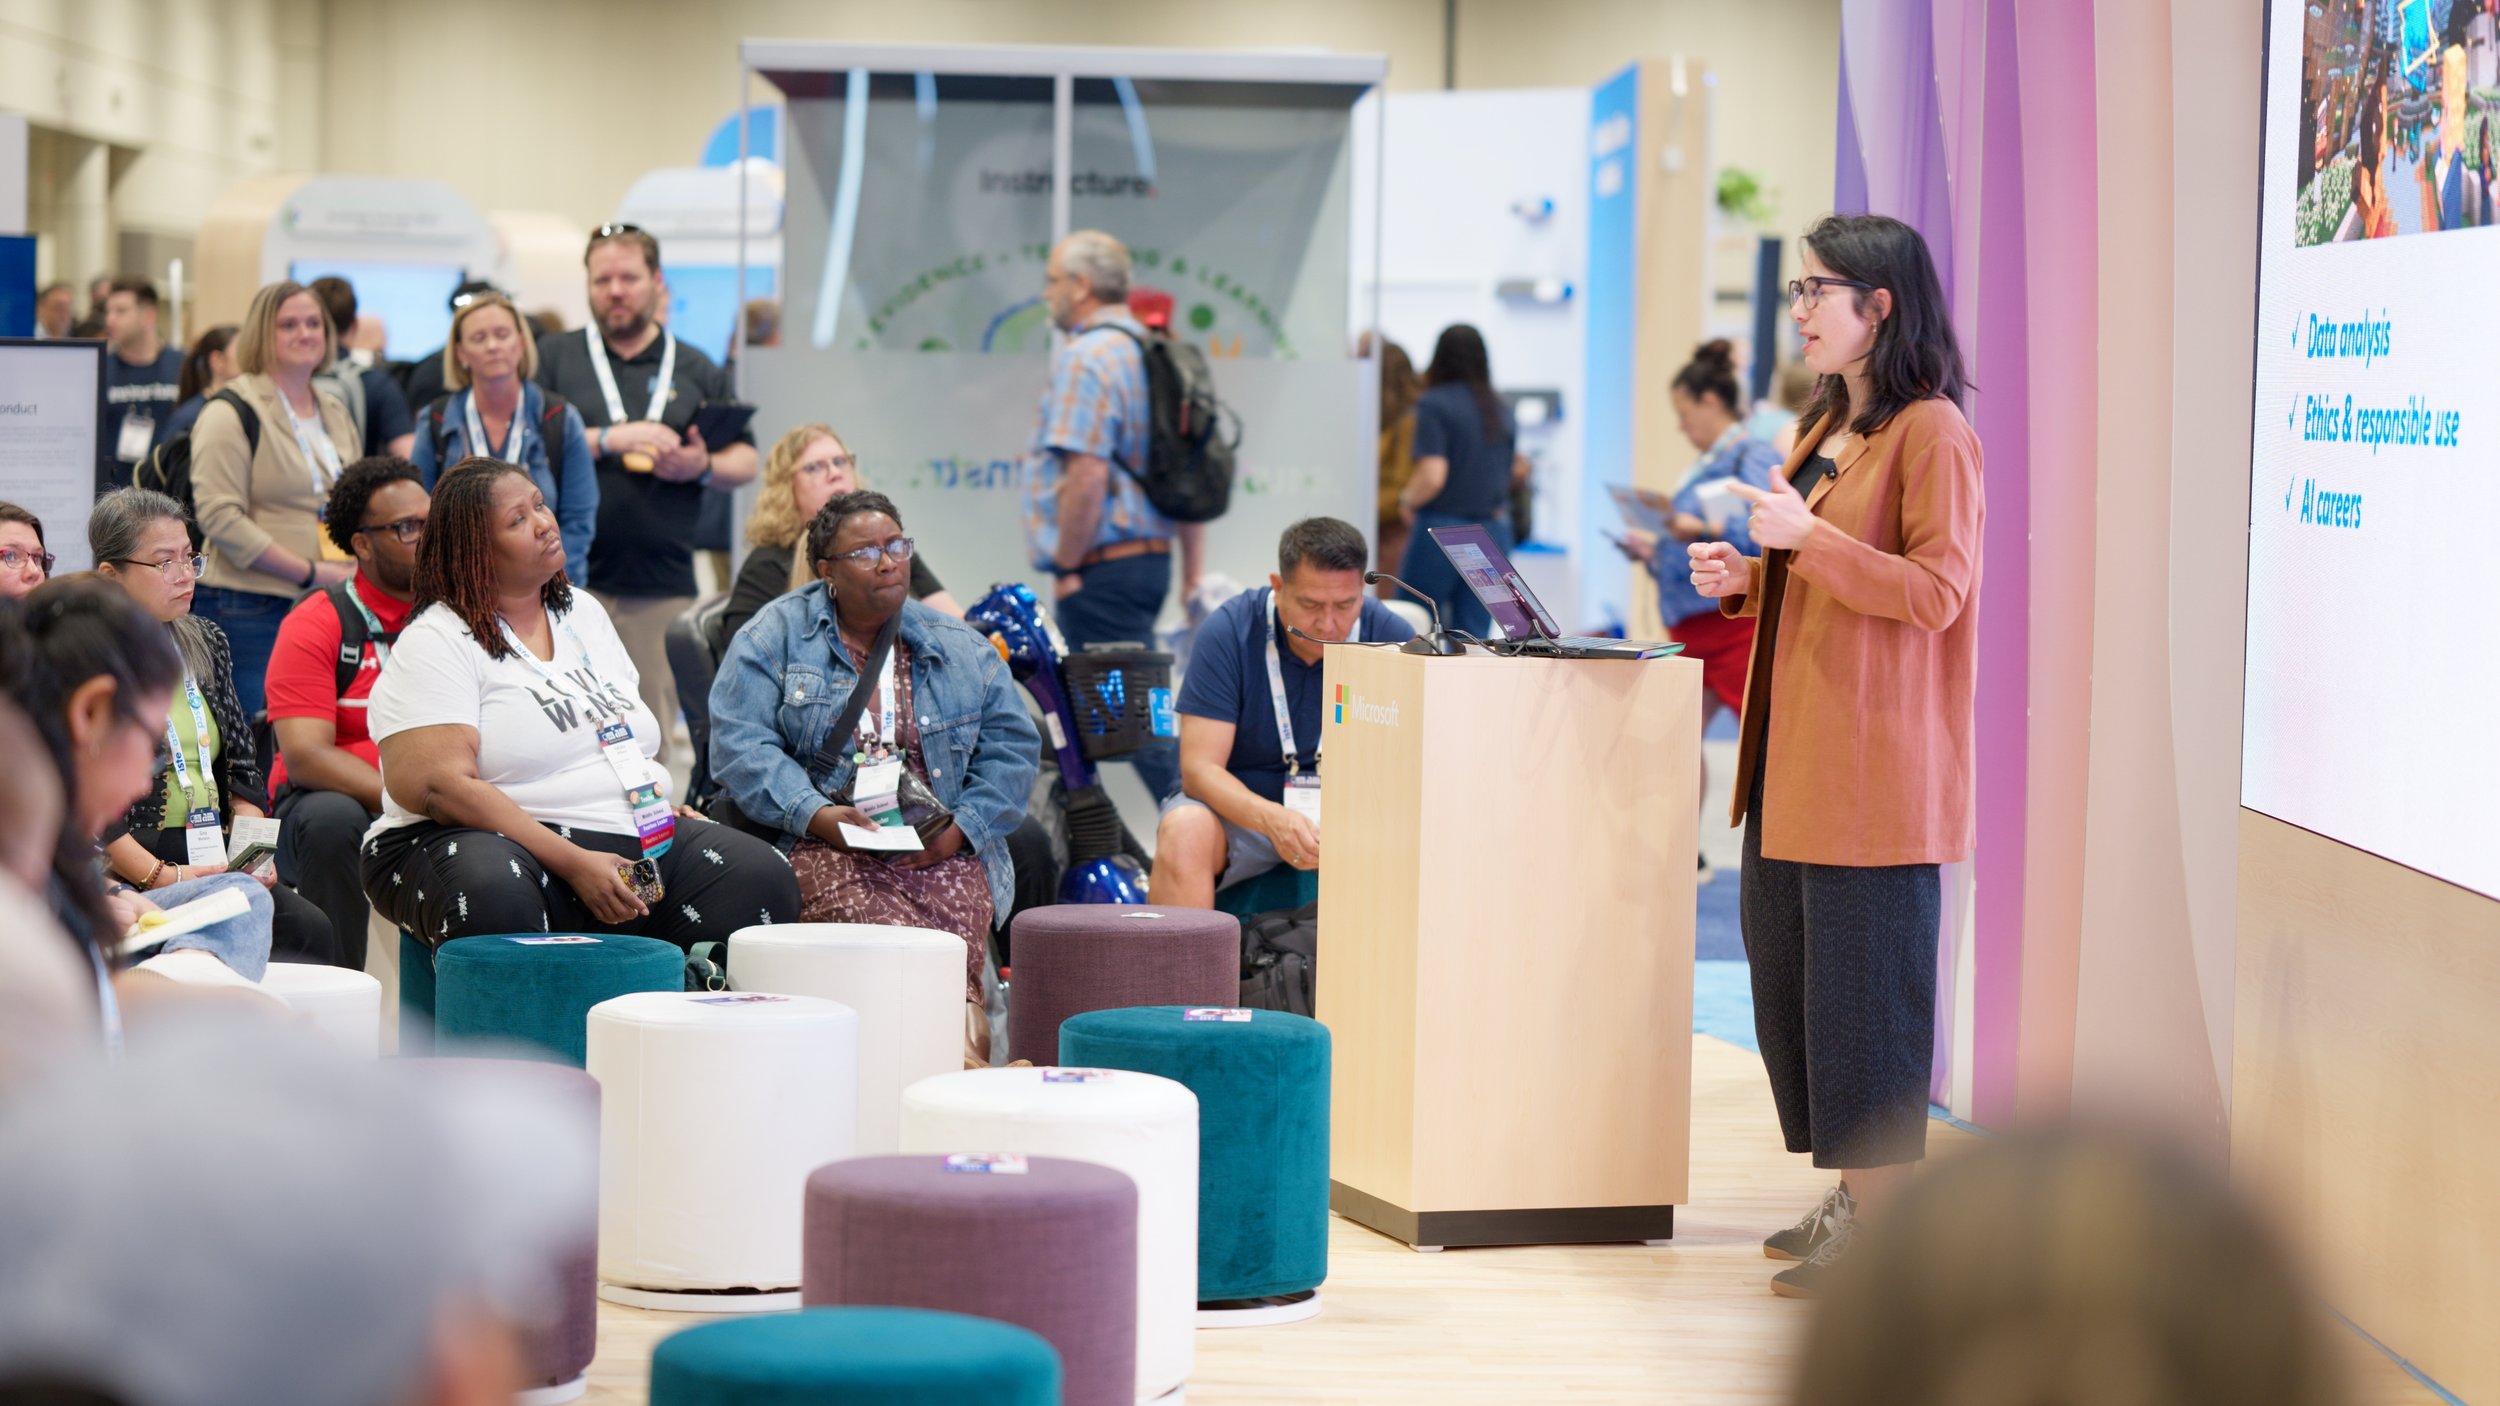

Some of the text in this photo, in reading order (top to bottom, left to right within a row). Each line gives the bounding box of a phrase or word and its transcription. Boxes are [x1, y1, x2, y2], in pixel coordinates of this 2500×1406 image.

[2307, 307, 2391, 369] Data analysis
[2304, 393, 2460, 456] Ethics & responsible use
[2300, 477, 2363, 529] AI careers
[883, 710, 894, 731] iste
[1351, 692, 1399, 728] Microsoft
[175, 751, 186, 773] iste
